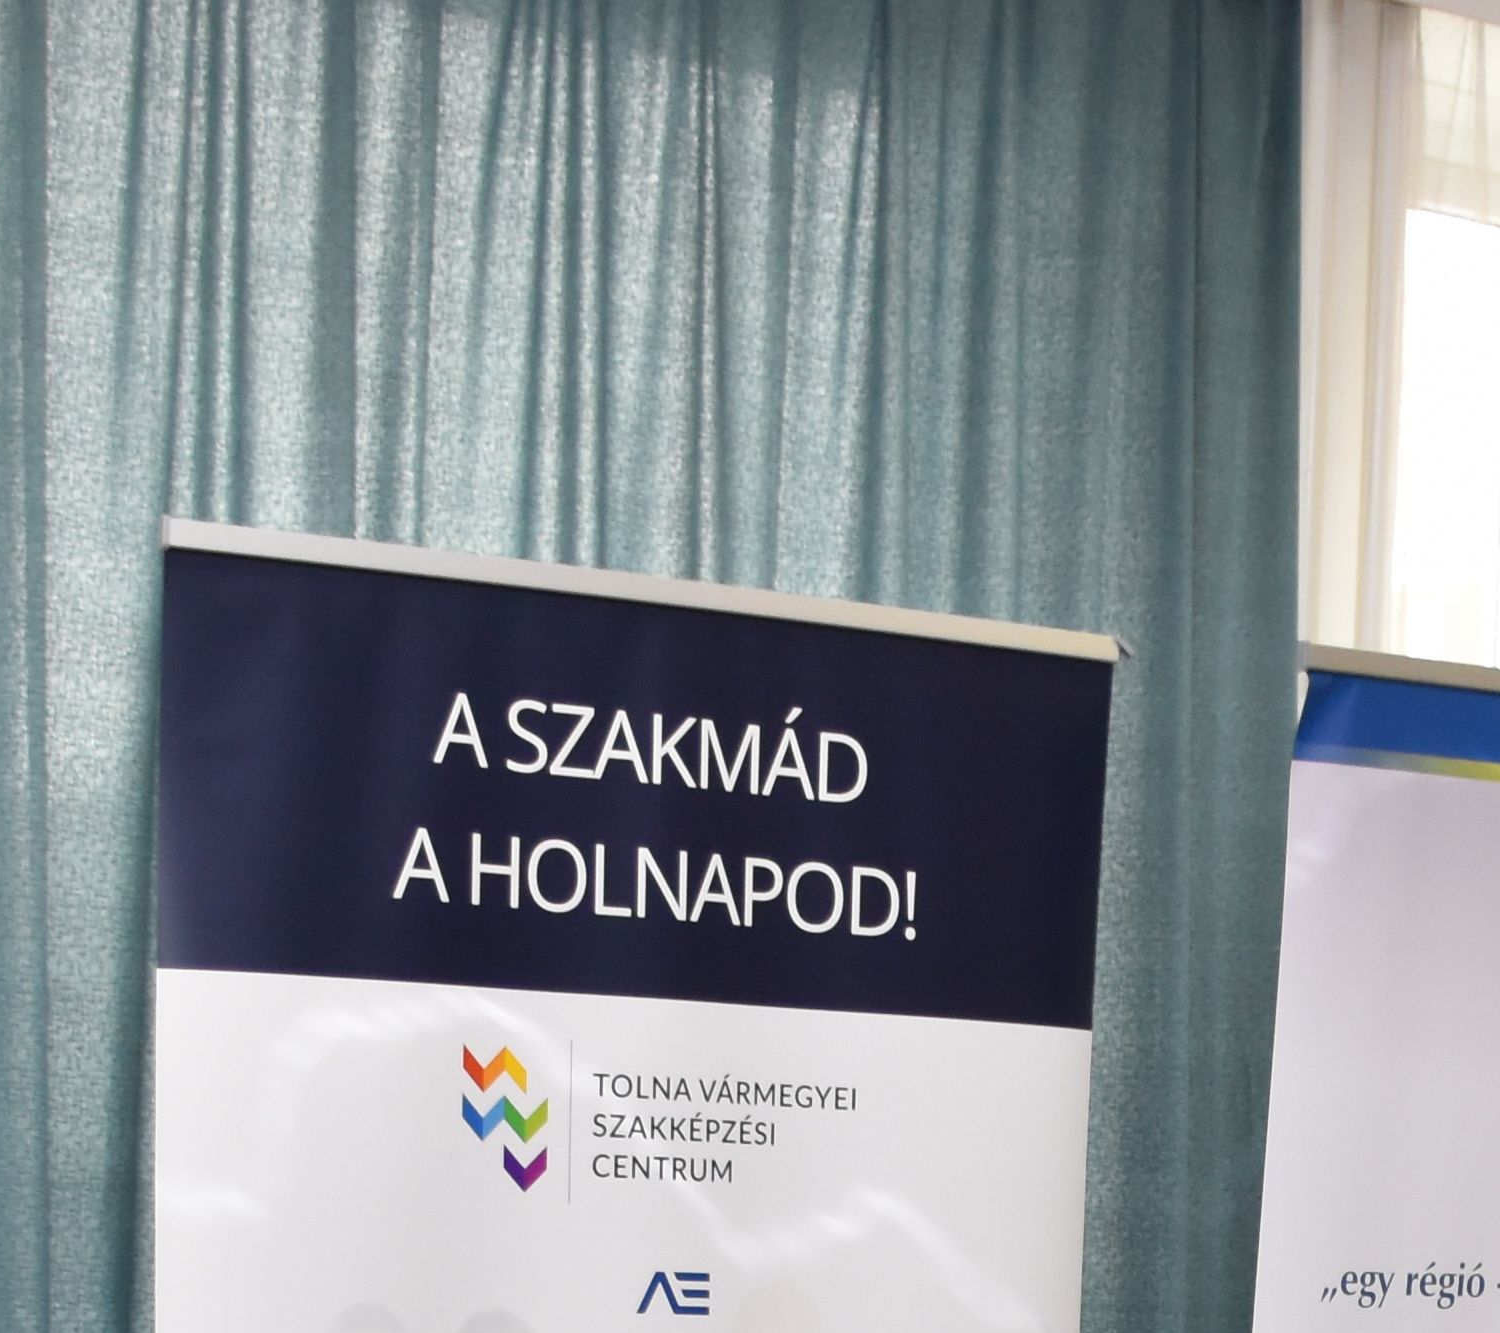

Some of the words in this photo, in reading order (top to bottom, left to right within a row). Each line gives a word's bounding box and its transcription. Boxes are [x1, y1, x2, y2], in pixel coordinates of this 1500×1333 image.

[432, 691, 489, 769] A
[506, 698, 868, 804] SZAKMÁD
[393, 826, 450, 904] A
[470, 833, 918, 942] HOLNAPOD!
[593, 1073, 693, 1105] TOLNA
[699, 1074, 858, 1113] VÁRMEGYEI
[592, 1110, 777, 1147] SZAKKÉPZÉSI
[592, 1153, 733, 1184] CENTRUM
[1405, 1262, 1485, 1315] régió
